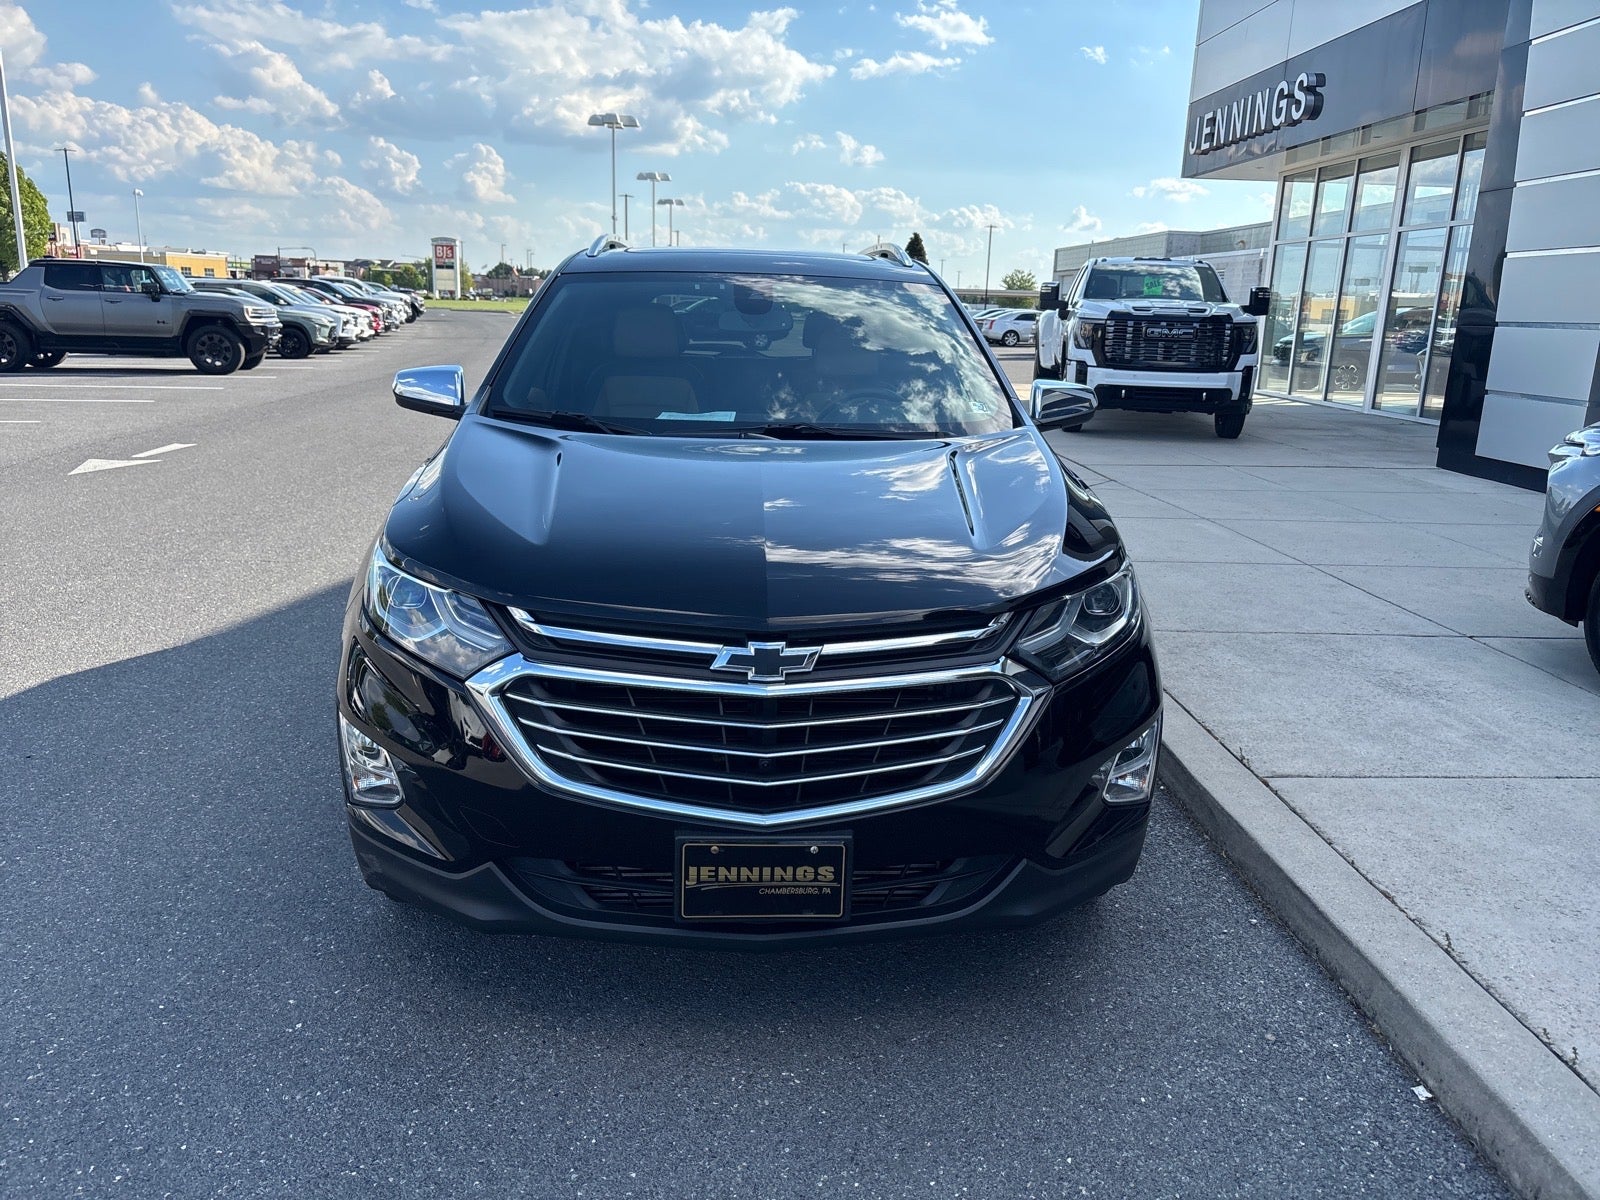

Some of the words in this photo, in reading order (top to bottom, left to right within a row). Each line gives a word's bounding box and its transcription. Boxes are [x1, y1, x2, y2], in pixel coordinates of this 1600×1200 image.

[1189, 72, 1313, 155] JENNINGS
[1145, 278, 1163, 290] SALE
[1146, 327, 1194, 338] GMC
[685, 866, 835, 885] JENNINGS
[758, 887, 820, 896] CHAMBERSBURG,
[822, 887, 831, 895] PA
